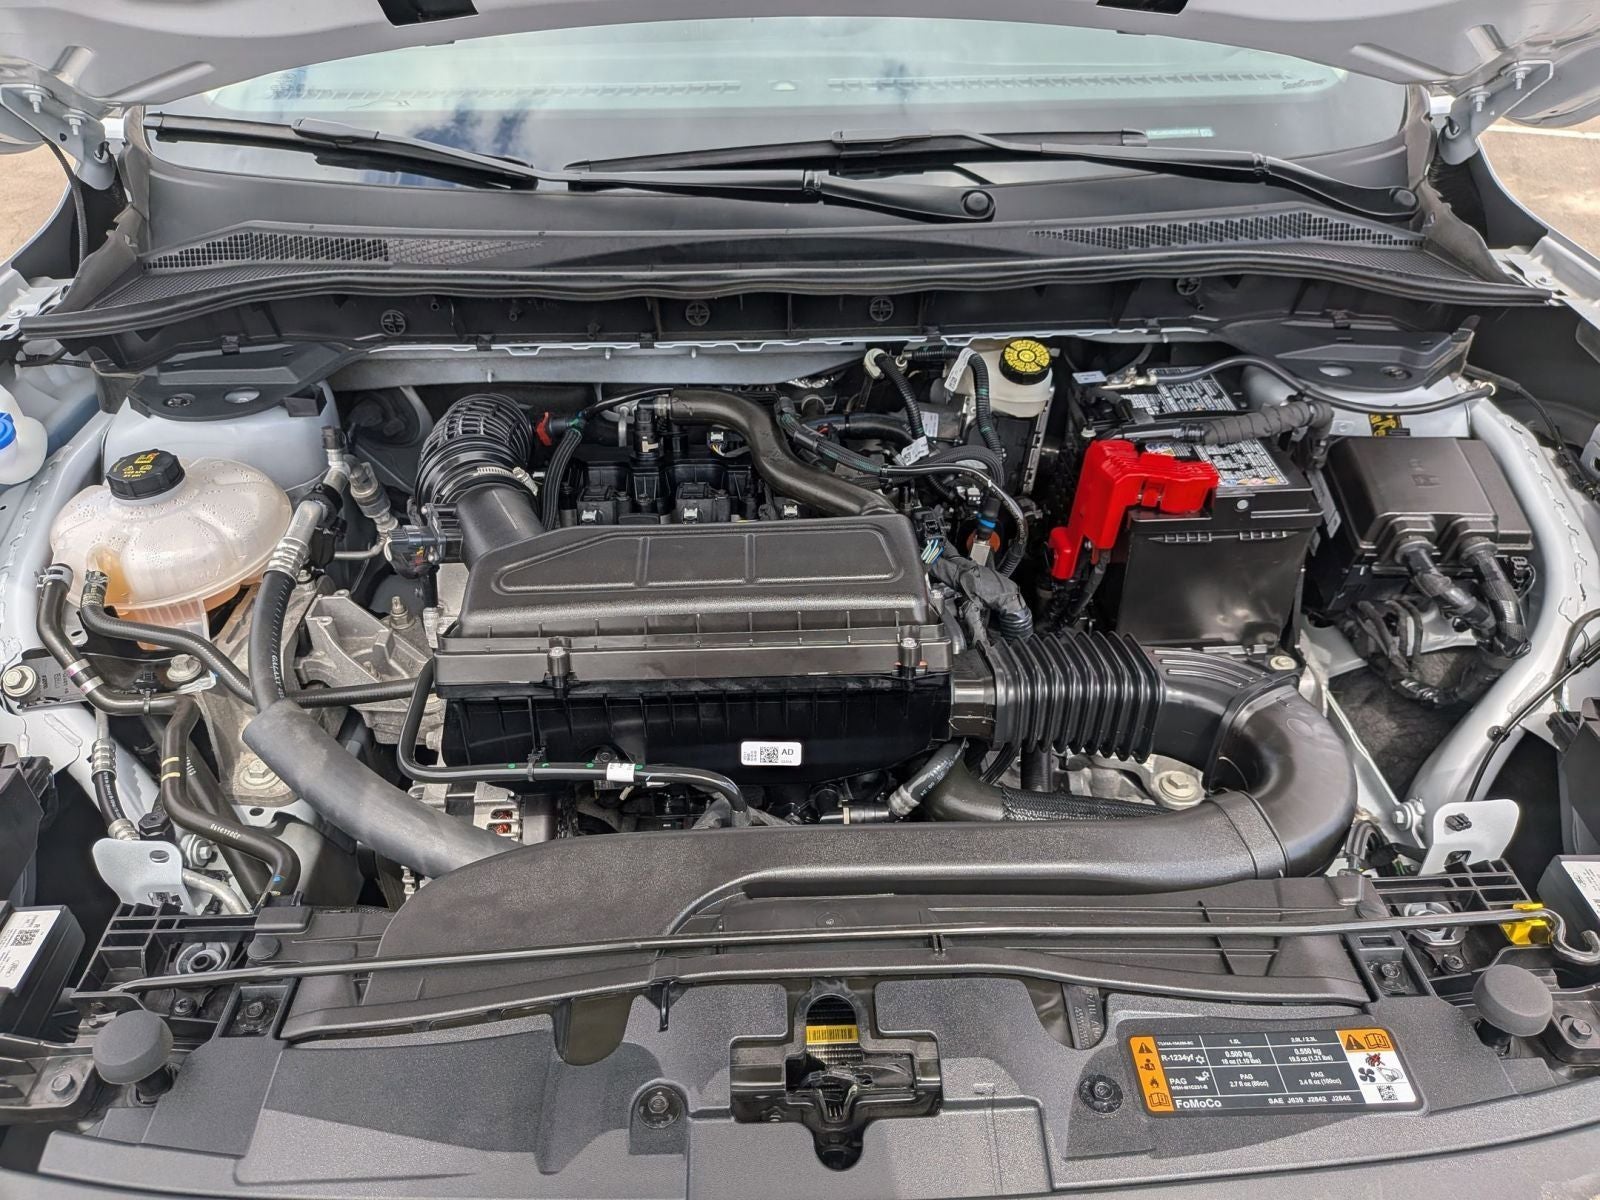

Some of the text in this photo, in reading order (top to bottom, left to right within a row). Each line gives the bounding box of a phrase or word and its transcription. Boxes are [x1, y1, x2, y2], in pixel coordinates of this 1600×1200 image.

[1224, 1050, 1253, 1059] 0.500 kg
[1312, 1047, 1322, 1055] kg
[1161, 1053, 1194, 1062] R-1234yf
[1175, 1099, 1222, 1108] FoMoCo
